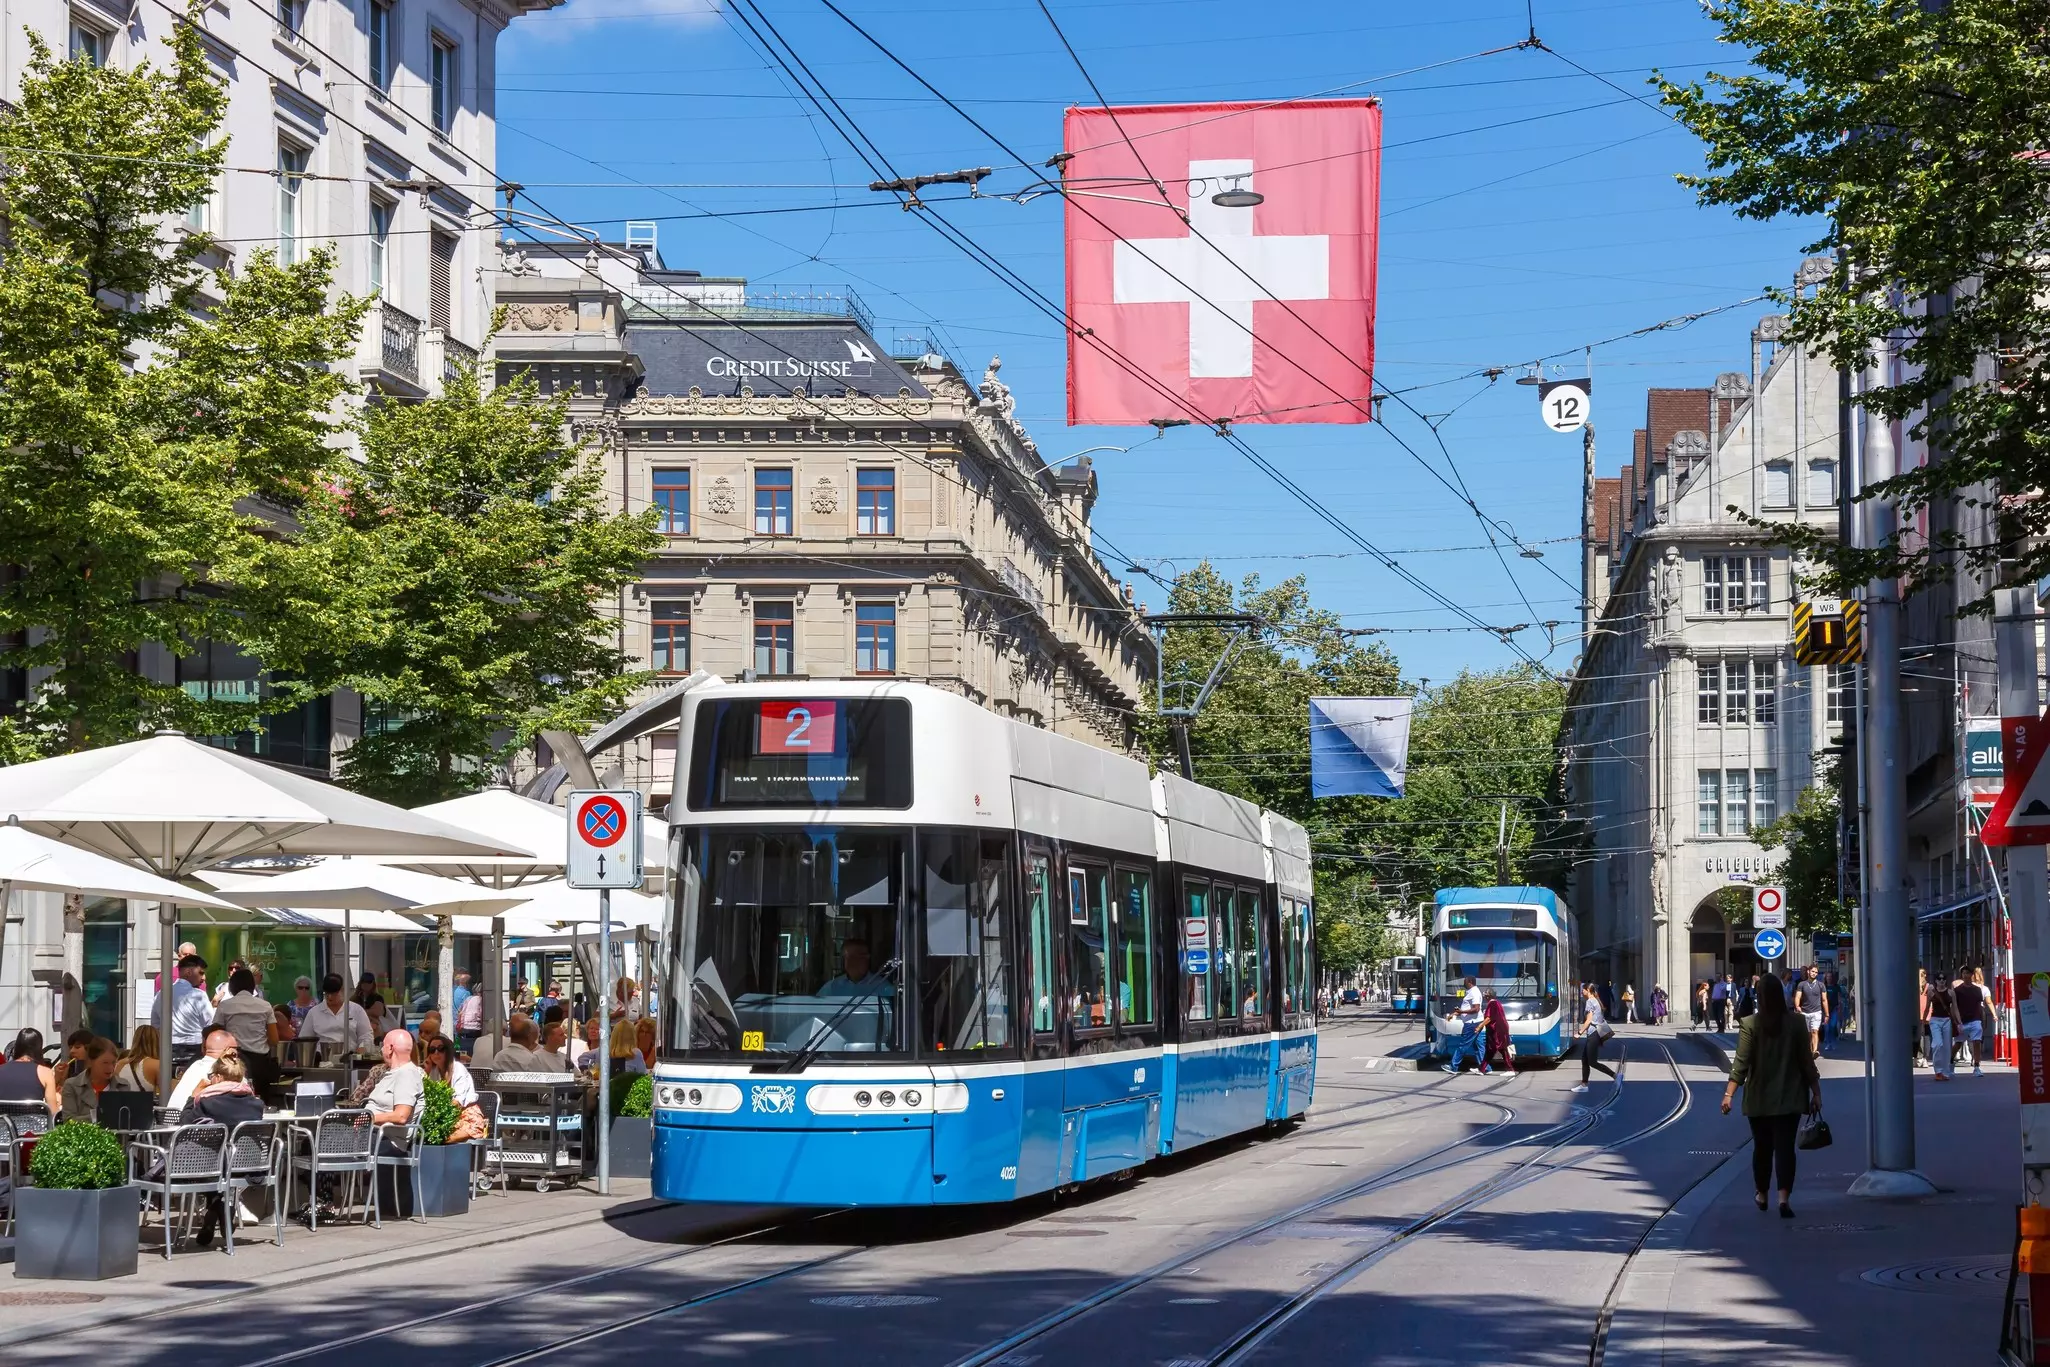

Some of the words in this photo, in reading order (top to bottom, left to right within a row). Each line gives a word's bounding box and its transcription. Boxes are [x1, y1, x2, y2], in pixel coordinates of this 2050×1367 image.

[706, 356, 782, 377] CREDIT
[785, 356, 852, 377] SUISSE
[1552, 397, 1580, 419] 12
[1819, 604, 1835, 612] W8
[784, 707, 812, 747] 2
[1706, 857, 1770, 872] GRIEDER
[743, 1034, 760, 1048] 03
[2032, 1037, 2045, 1095] SOLTERM
[1000, 1166, 1017, 1180] 4023
